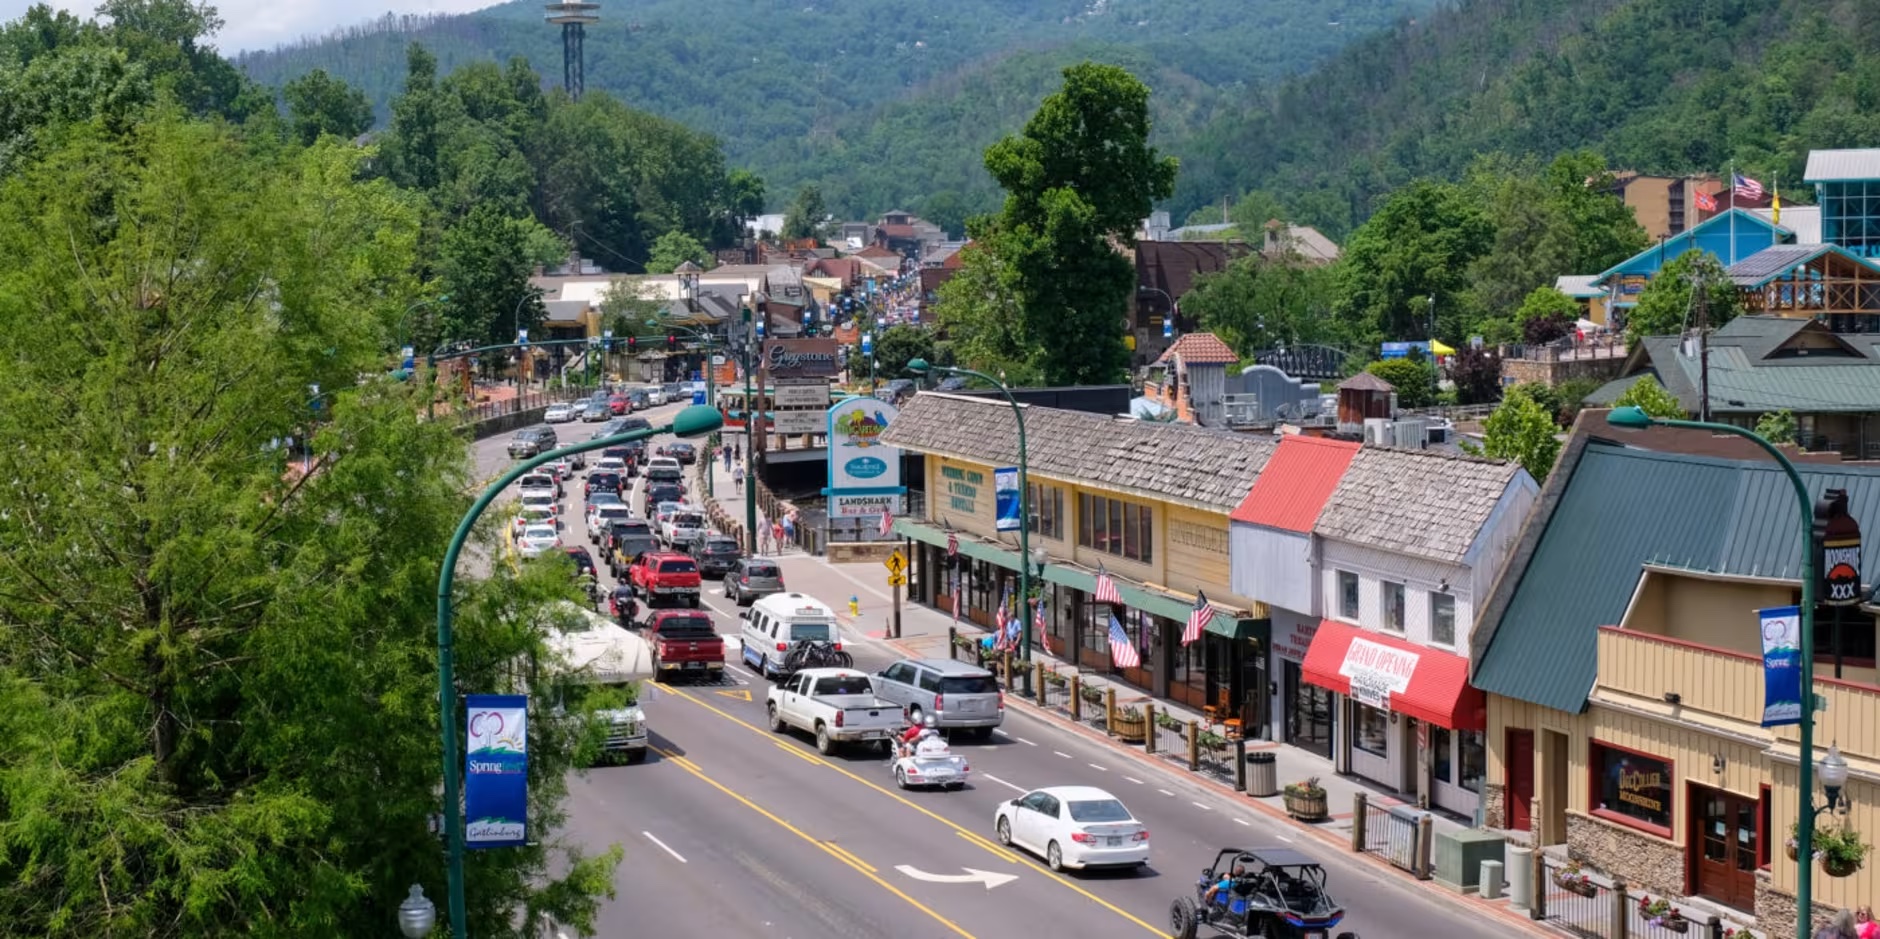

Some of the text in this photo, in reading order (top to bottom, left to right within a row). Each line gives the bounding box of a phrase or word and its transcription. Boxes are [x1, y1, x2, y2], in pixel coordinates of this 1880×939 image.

[839, 497, 892, 505] LANDSHARK
[1824, 547, 1860, 579] MOONSHINE
[1831, 582, 1855, 599] XXX
[1347, 641, 1378, 667] GRAND
[1376, 650, 1415, 678] OPENING
